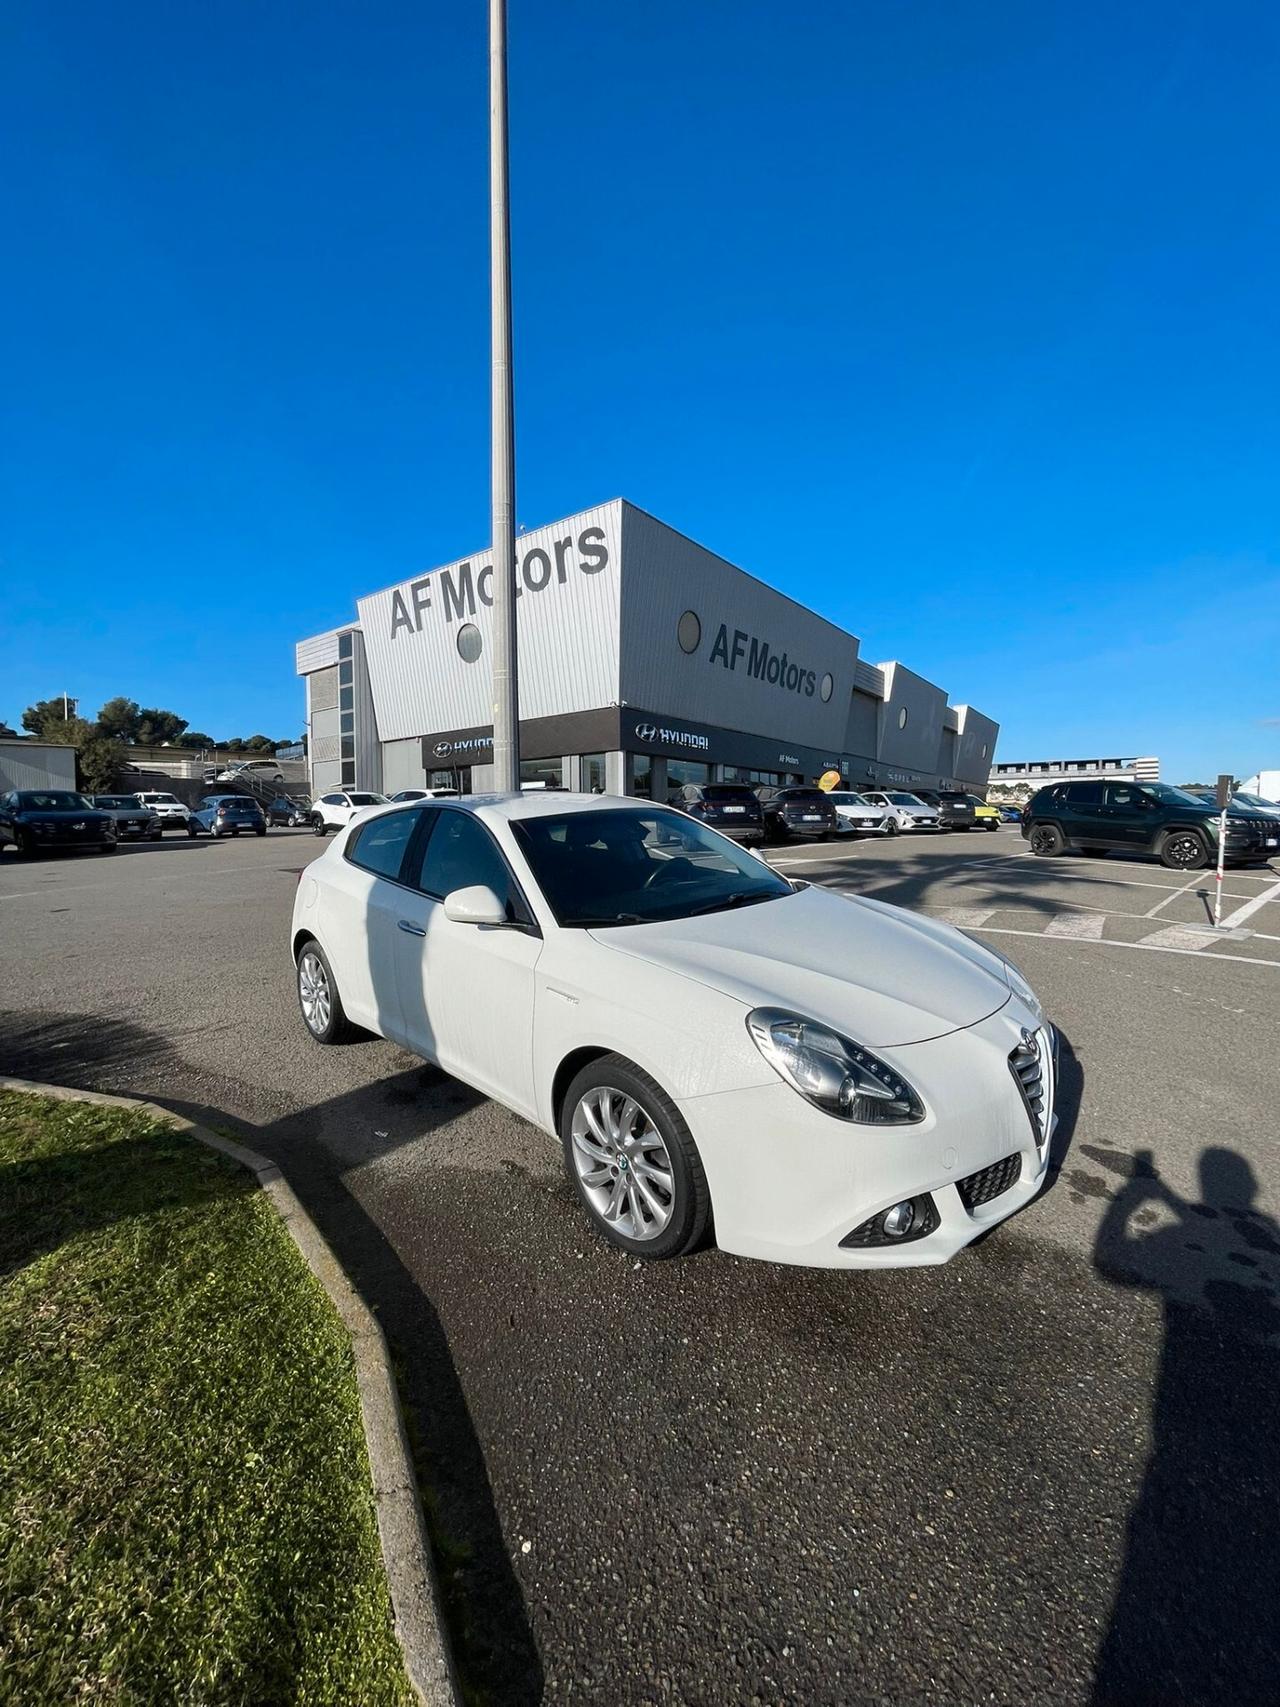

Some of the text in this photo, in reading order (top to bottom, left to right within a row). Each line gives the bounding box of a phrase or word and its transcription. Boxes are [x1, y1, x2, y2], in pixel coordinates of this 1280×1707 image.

[391, 527, 609, 640] AF Moors
[709, 623, 816, 697] AF Motors
[660, 728, 709, 750] HYUNDAI
